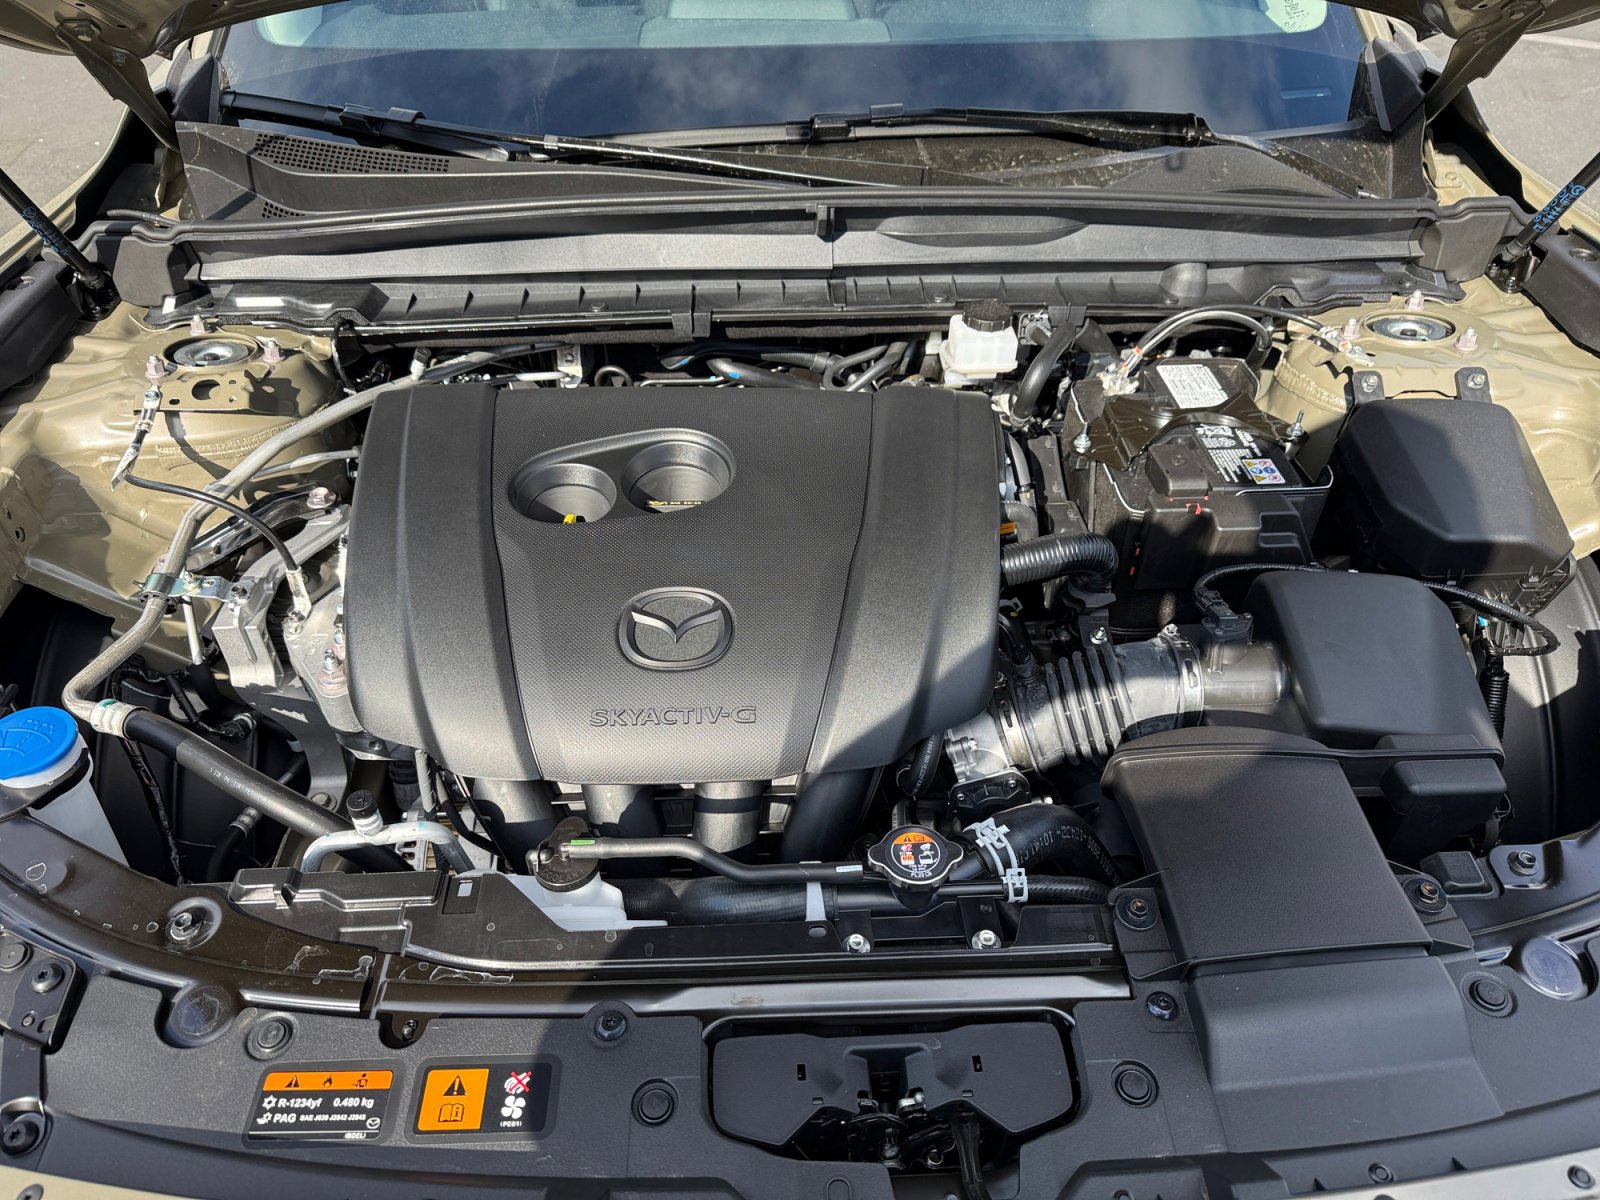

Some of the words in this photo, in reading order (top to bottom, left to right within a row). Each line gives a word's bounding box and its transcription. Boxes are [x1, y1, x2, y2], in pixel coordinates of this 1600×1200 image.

[589, 705, 757, 727] SKYACTIV-G
[277, 1097, 323, 1110] R-1234yf
[333, 1097, 360, 1108] 0.480
[361, 1097, 375, 1109] kg
[273, 1113, 297, 1124] PAG
